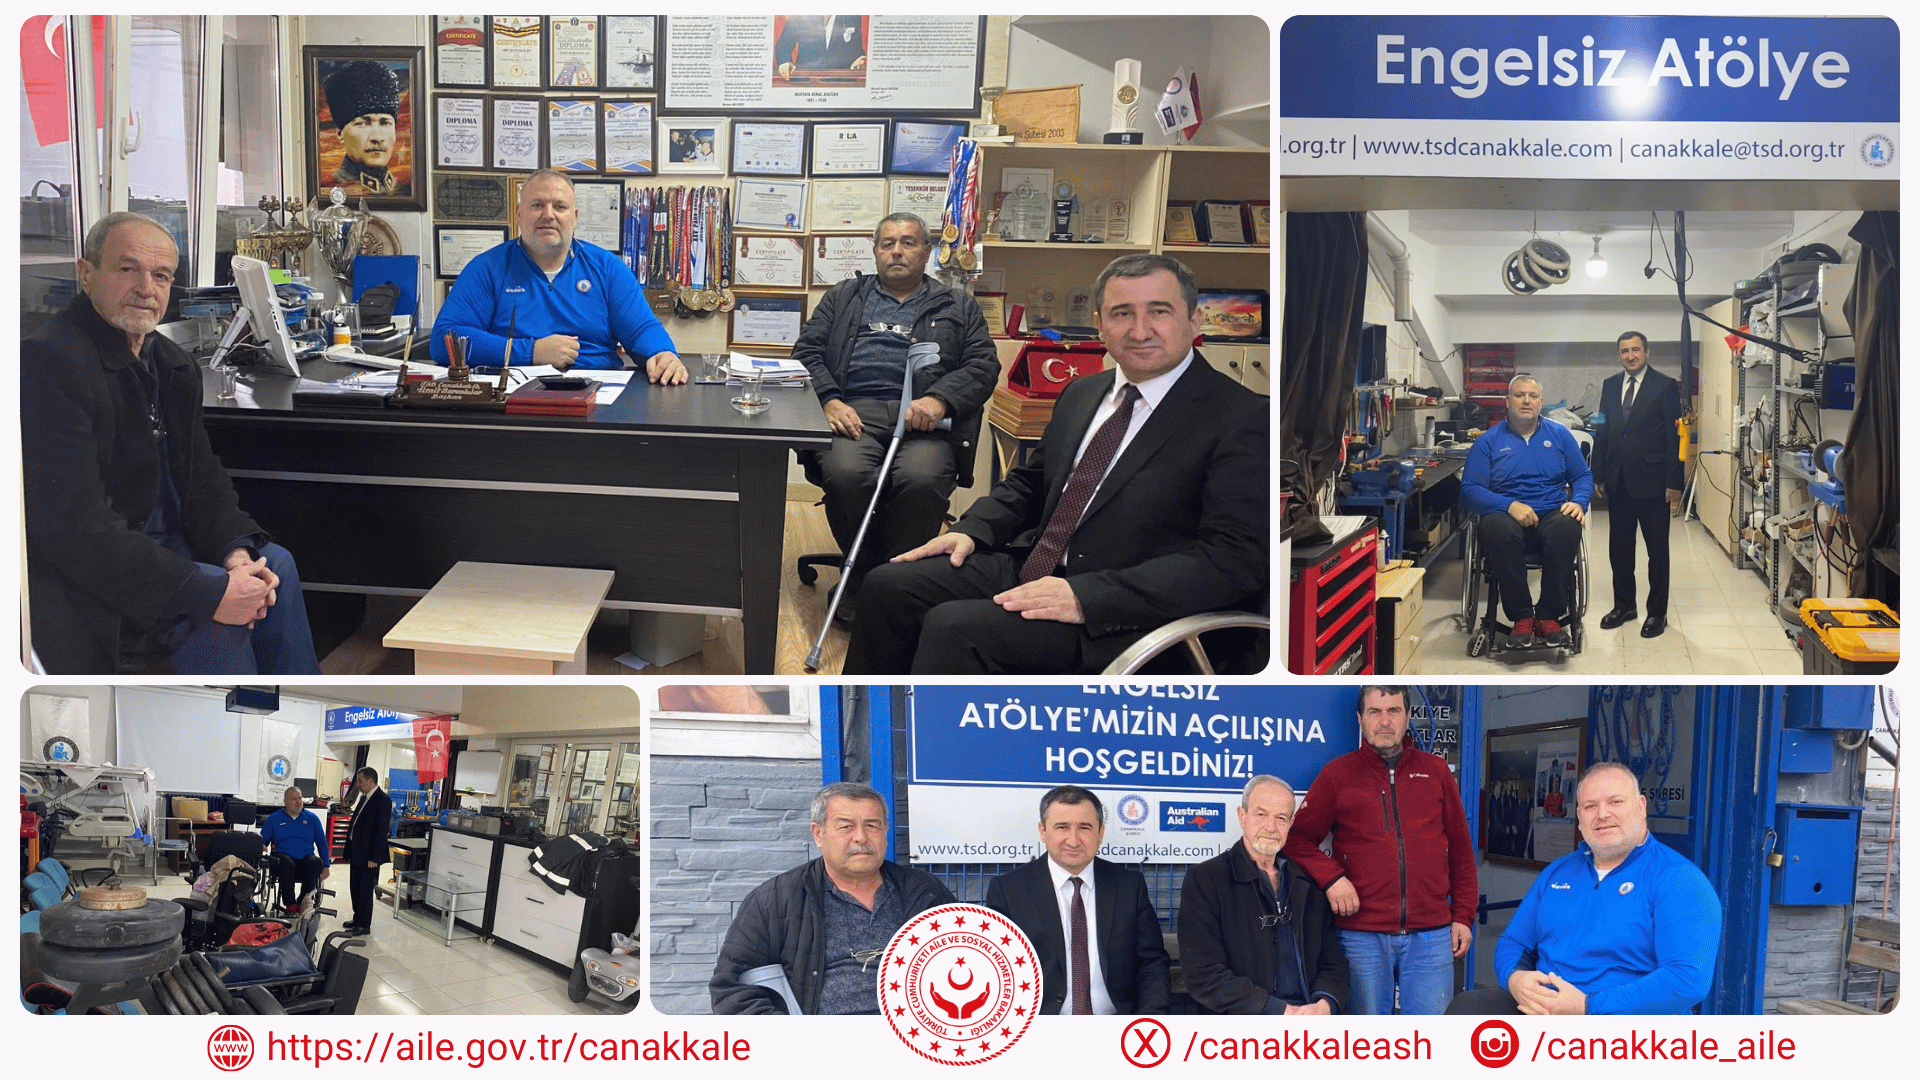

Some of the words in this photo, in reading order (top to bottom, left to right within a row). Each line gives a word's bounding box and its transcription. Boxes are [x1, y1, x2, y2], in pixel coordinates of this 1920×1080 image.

[1376, 34, 1627, 99] Engelsiz
[1645, 36, 1850, 101] Atölye
[502, 119, 533, 127] DIPLOMA
[1280, 135, 1347, 159] .org.tr
[1363, 136, 1613, 159] www.tsdcanakkale.com
[1630, 138, 1846, 162] canakkale@tsd.org.tr
[344, 707, 376, 725] Engelsiz
[1409, 702, 1450, 720] KİYE
[959, 697, 1177, 737] ATÖLYE'MİZİN
[1184, 712, 1326, 747] AÇILIŞINA
[1405, 728, 1457, 743] ATLAR
[1045, 746, 1254, 779] HOŞGELDİNİZ!
[1167, 806, 1220, 816] Australian
[1167, 816, 1185, 825] Aid
[918, 841, 1034, 859] www.tsd.org.tr
[1096, 843, 1214, 857] sdcanakkale.com
